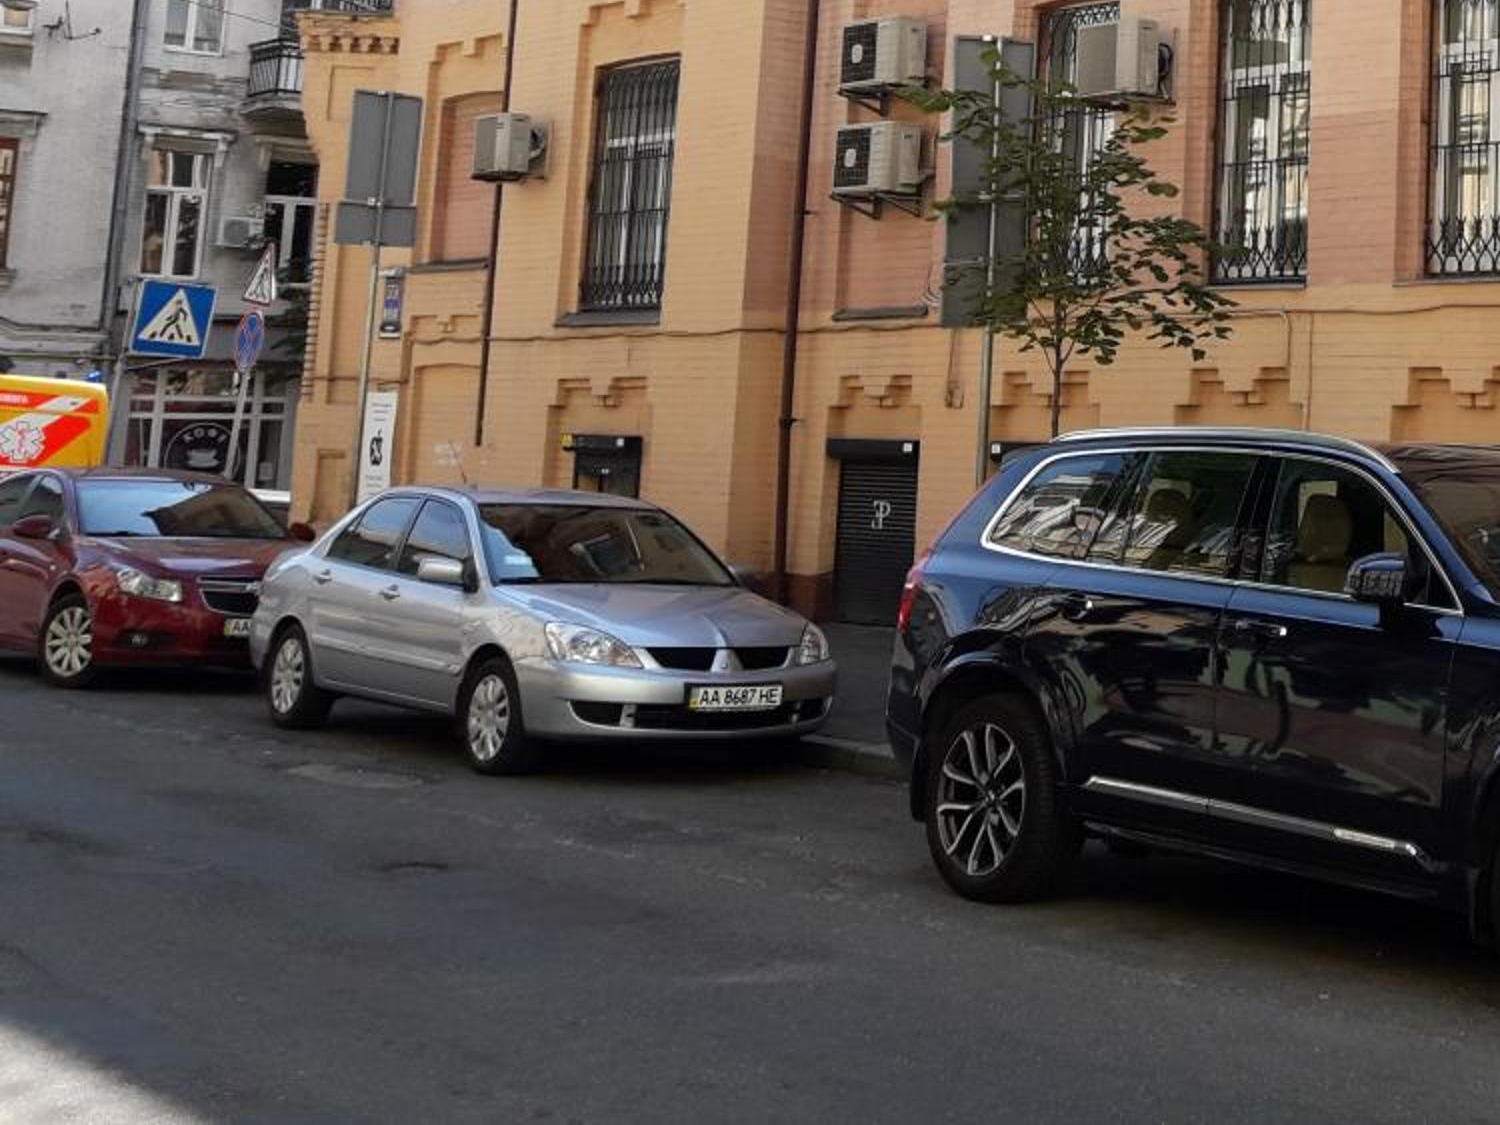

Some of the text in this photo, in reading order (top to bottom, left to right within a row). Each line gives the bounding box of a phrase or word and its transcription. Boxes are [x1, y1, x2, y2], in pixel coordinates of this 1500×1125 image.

[700, 688, 778, 705] AA 8687 HE
